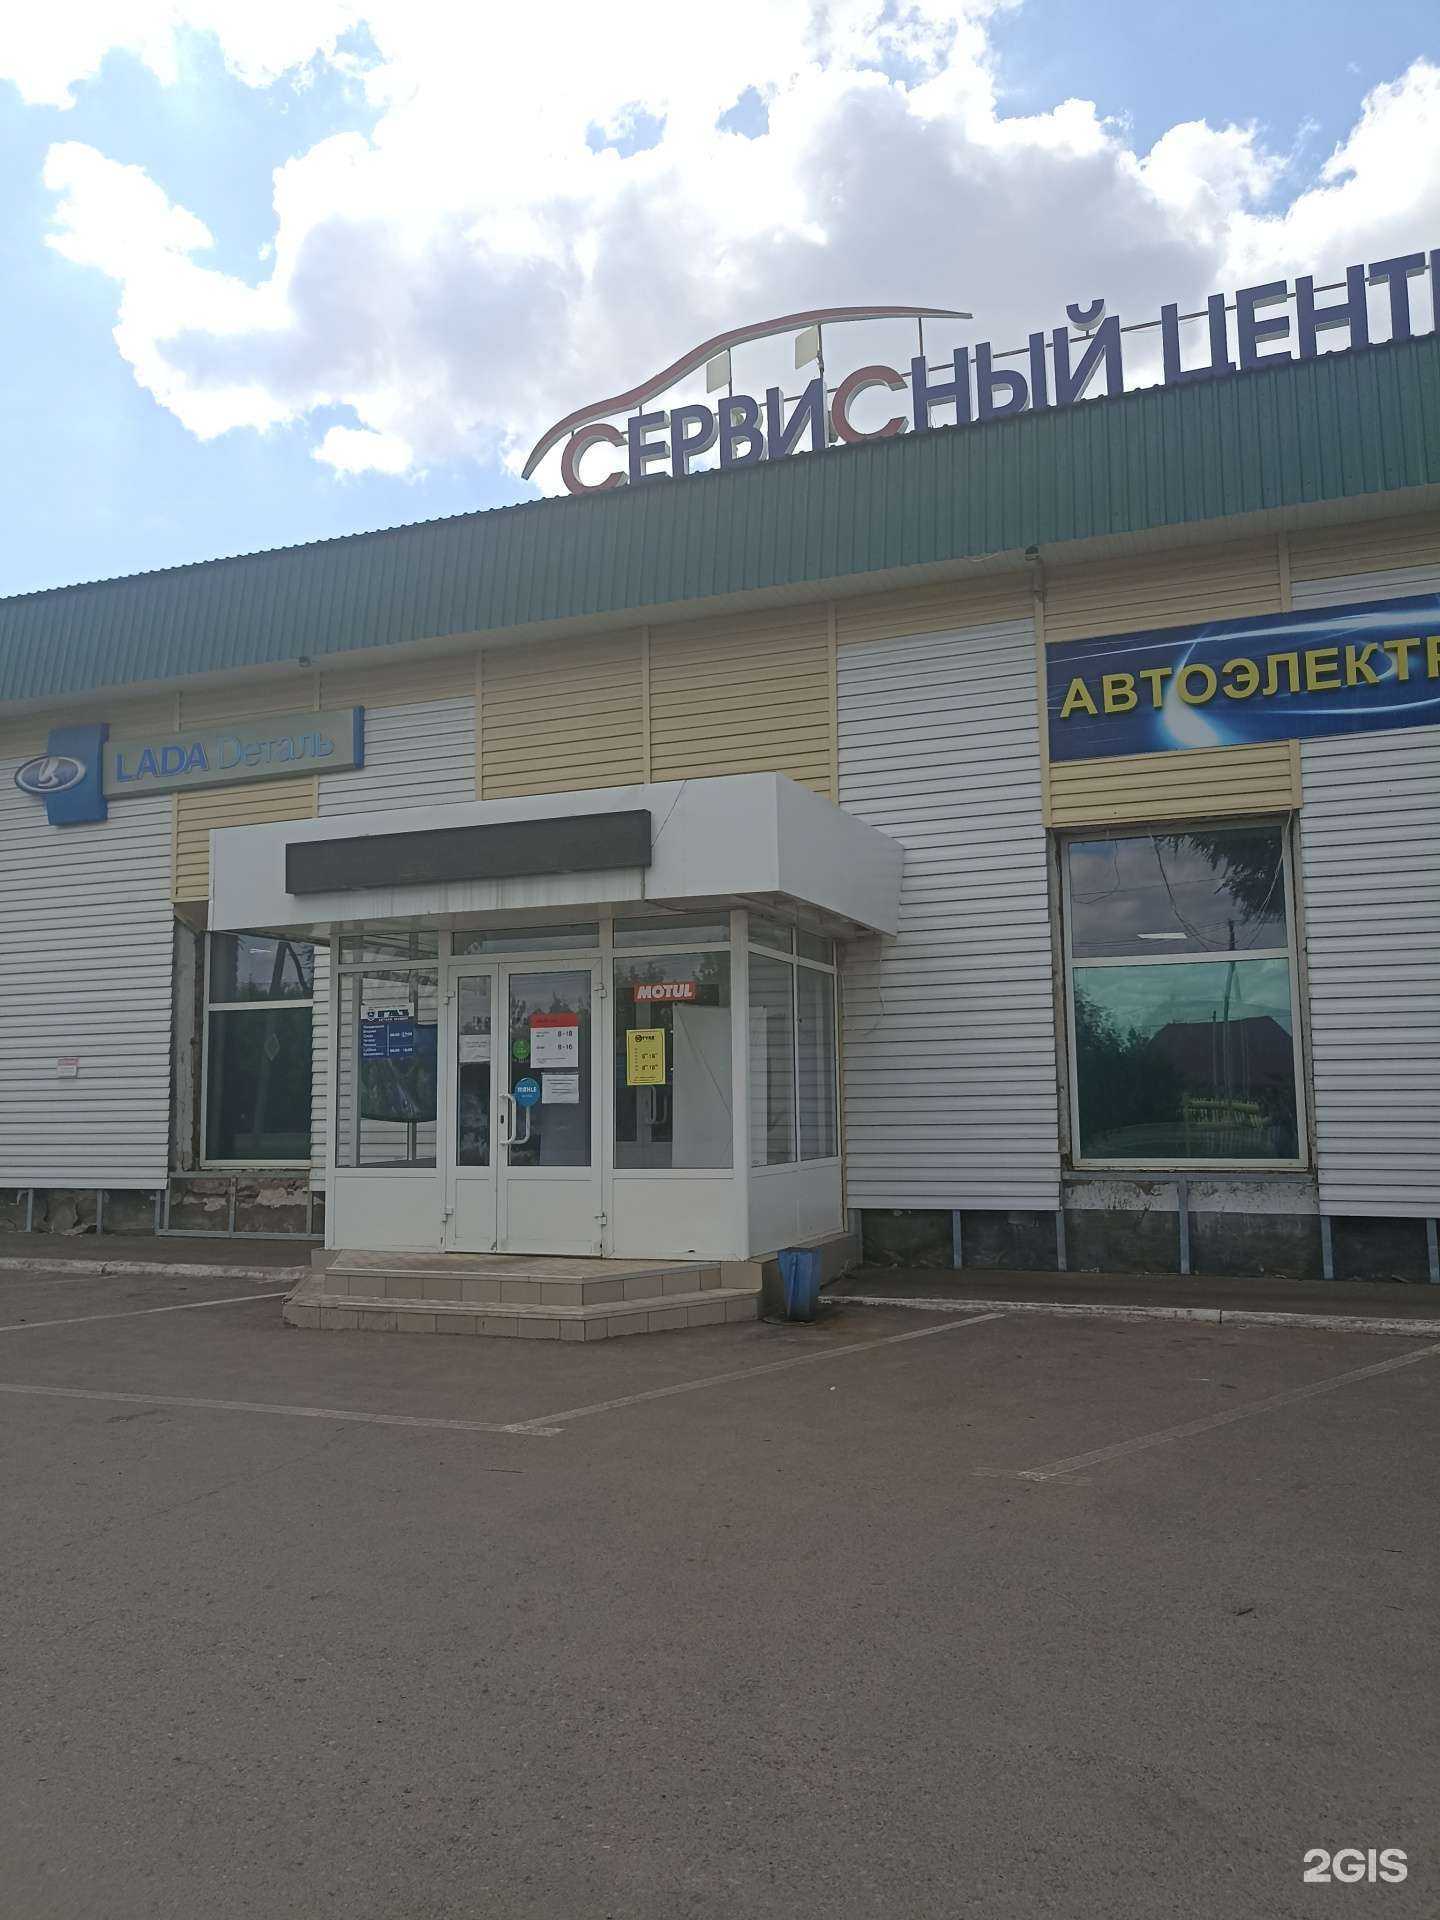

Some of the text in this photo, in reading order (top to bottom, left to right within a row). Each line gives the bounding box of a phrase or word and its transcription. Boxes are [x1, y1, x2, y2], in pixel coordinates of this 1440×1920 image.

[561, 298, 1124, 495] СЕРВИСНЫЙ
[116, 741, 208, 783] LADA
[637, 983, 693, 999] MOTUL
